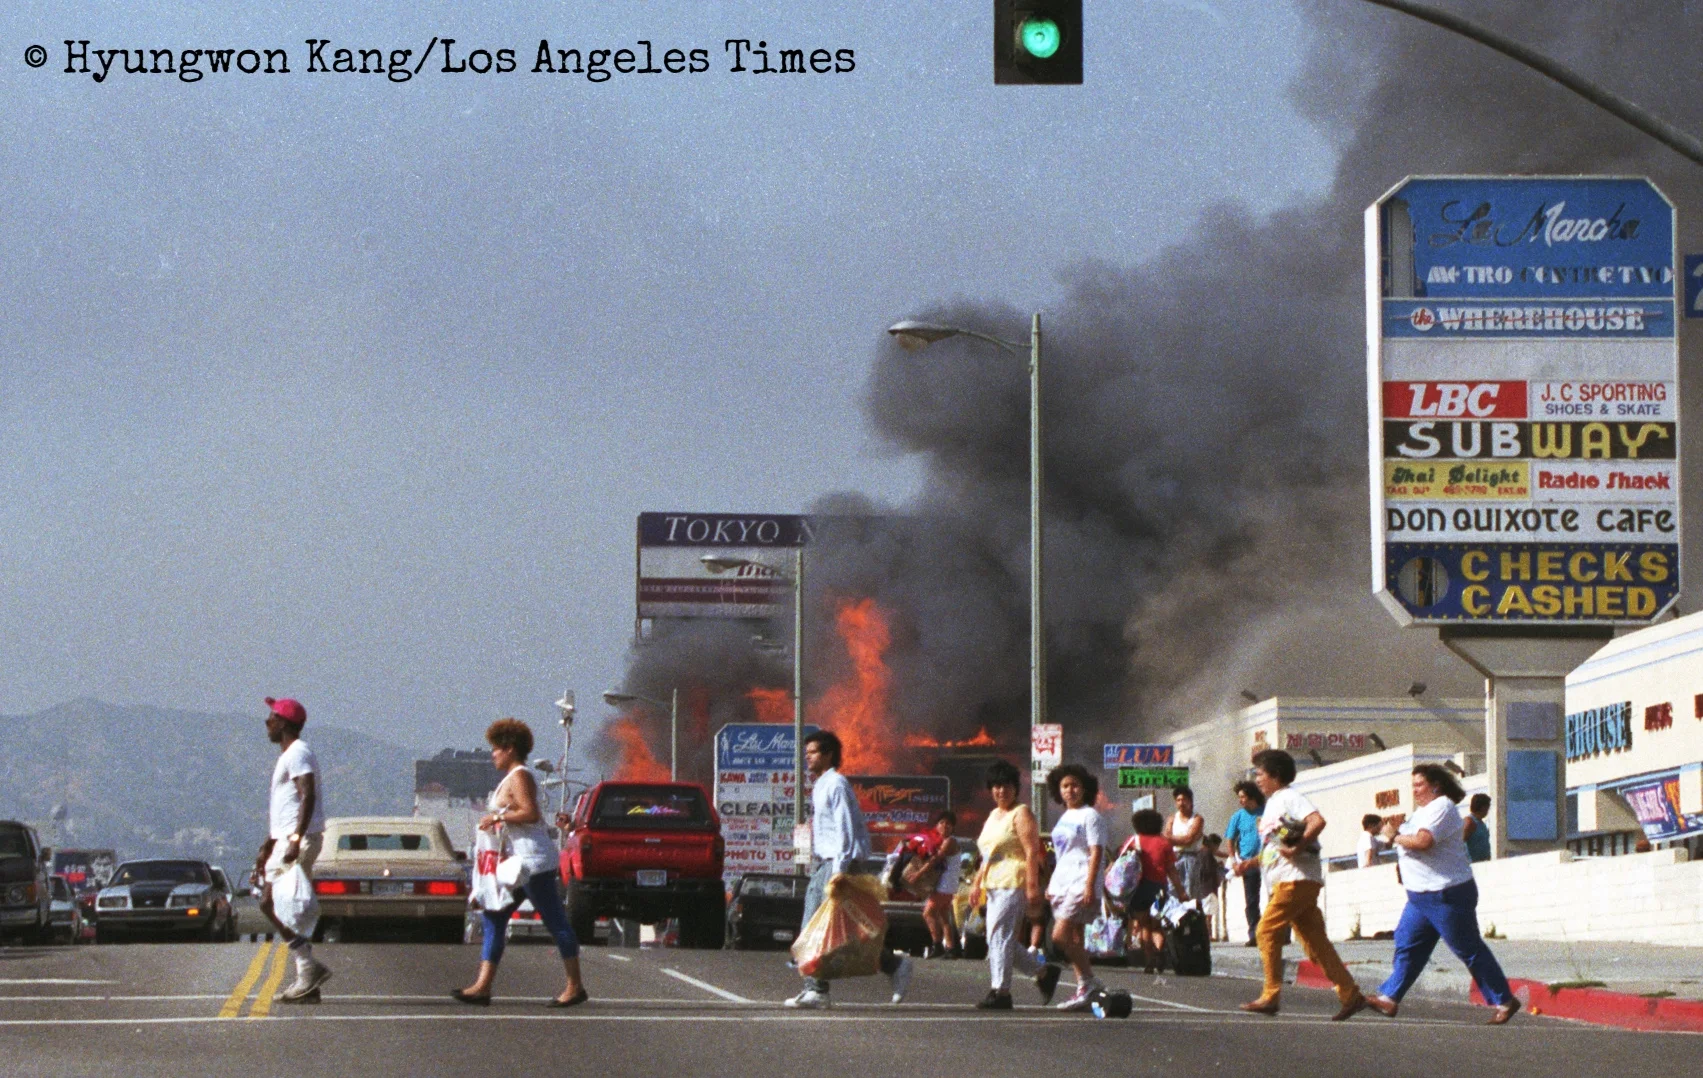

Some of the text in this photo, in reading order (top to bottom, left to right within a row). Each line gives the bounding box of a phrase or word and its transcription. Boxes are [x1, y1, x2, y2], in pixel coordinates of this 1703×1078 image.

[1412, 307, 1644, 331] the WHEREHOUSE
[1408, 383, 1500, 417] LBC
[1579, 383, 1667, 402] SPORTING
[1545, 403, 1661, 416] SHOES & SKATE
[1396, 422, 1670, 459] SUBWAY
[1539, 470, 1671, 490] Radio Shack
[665, 516, 780, 543] TOKYO
[1461, 551, 1669, 583] CHECKS
[1461, 585, 1658, 616] CASHED
[1565, 701, 1632, 761] EHOUSE
[720, 802, 815, 816] CLEANER
[724, 849, 767, 861] PHOTO
